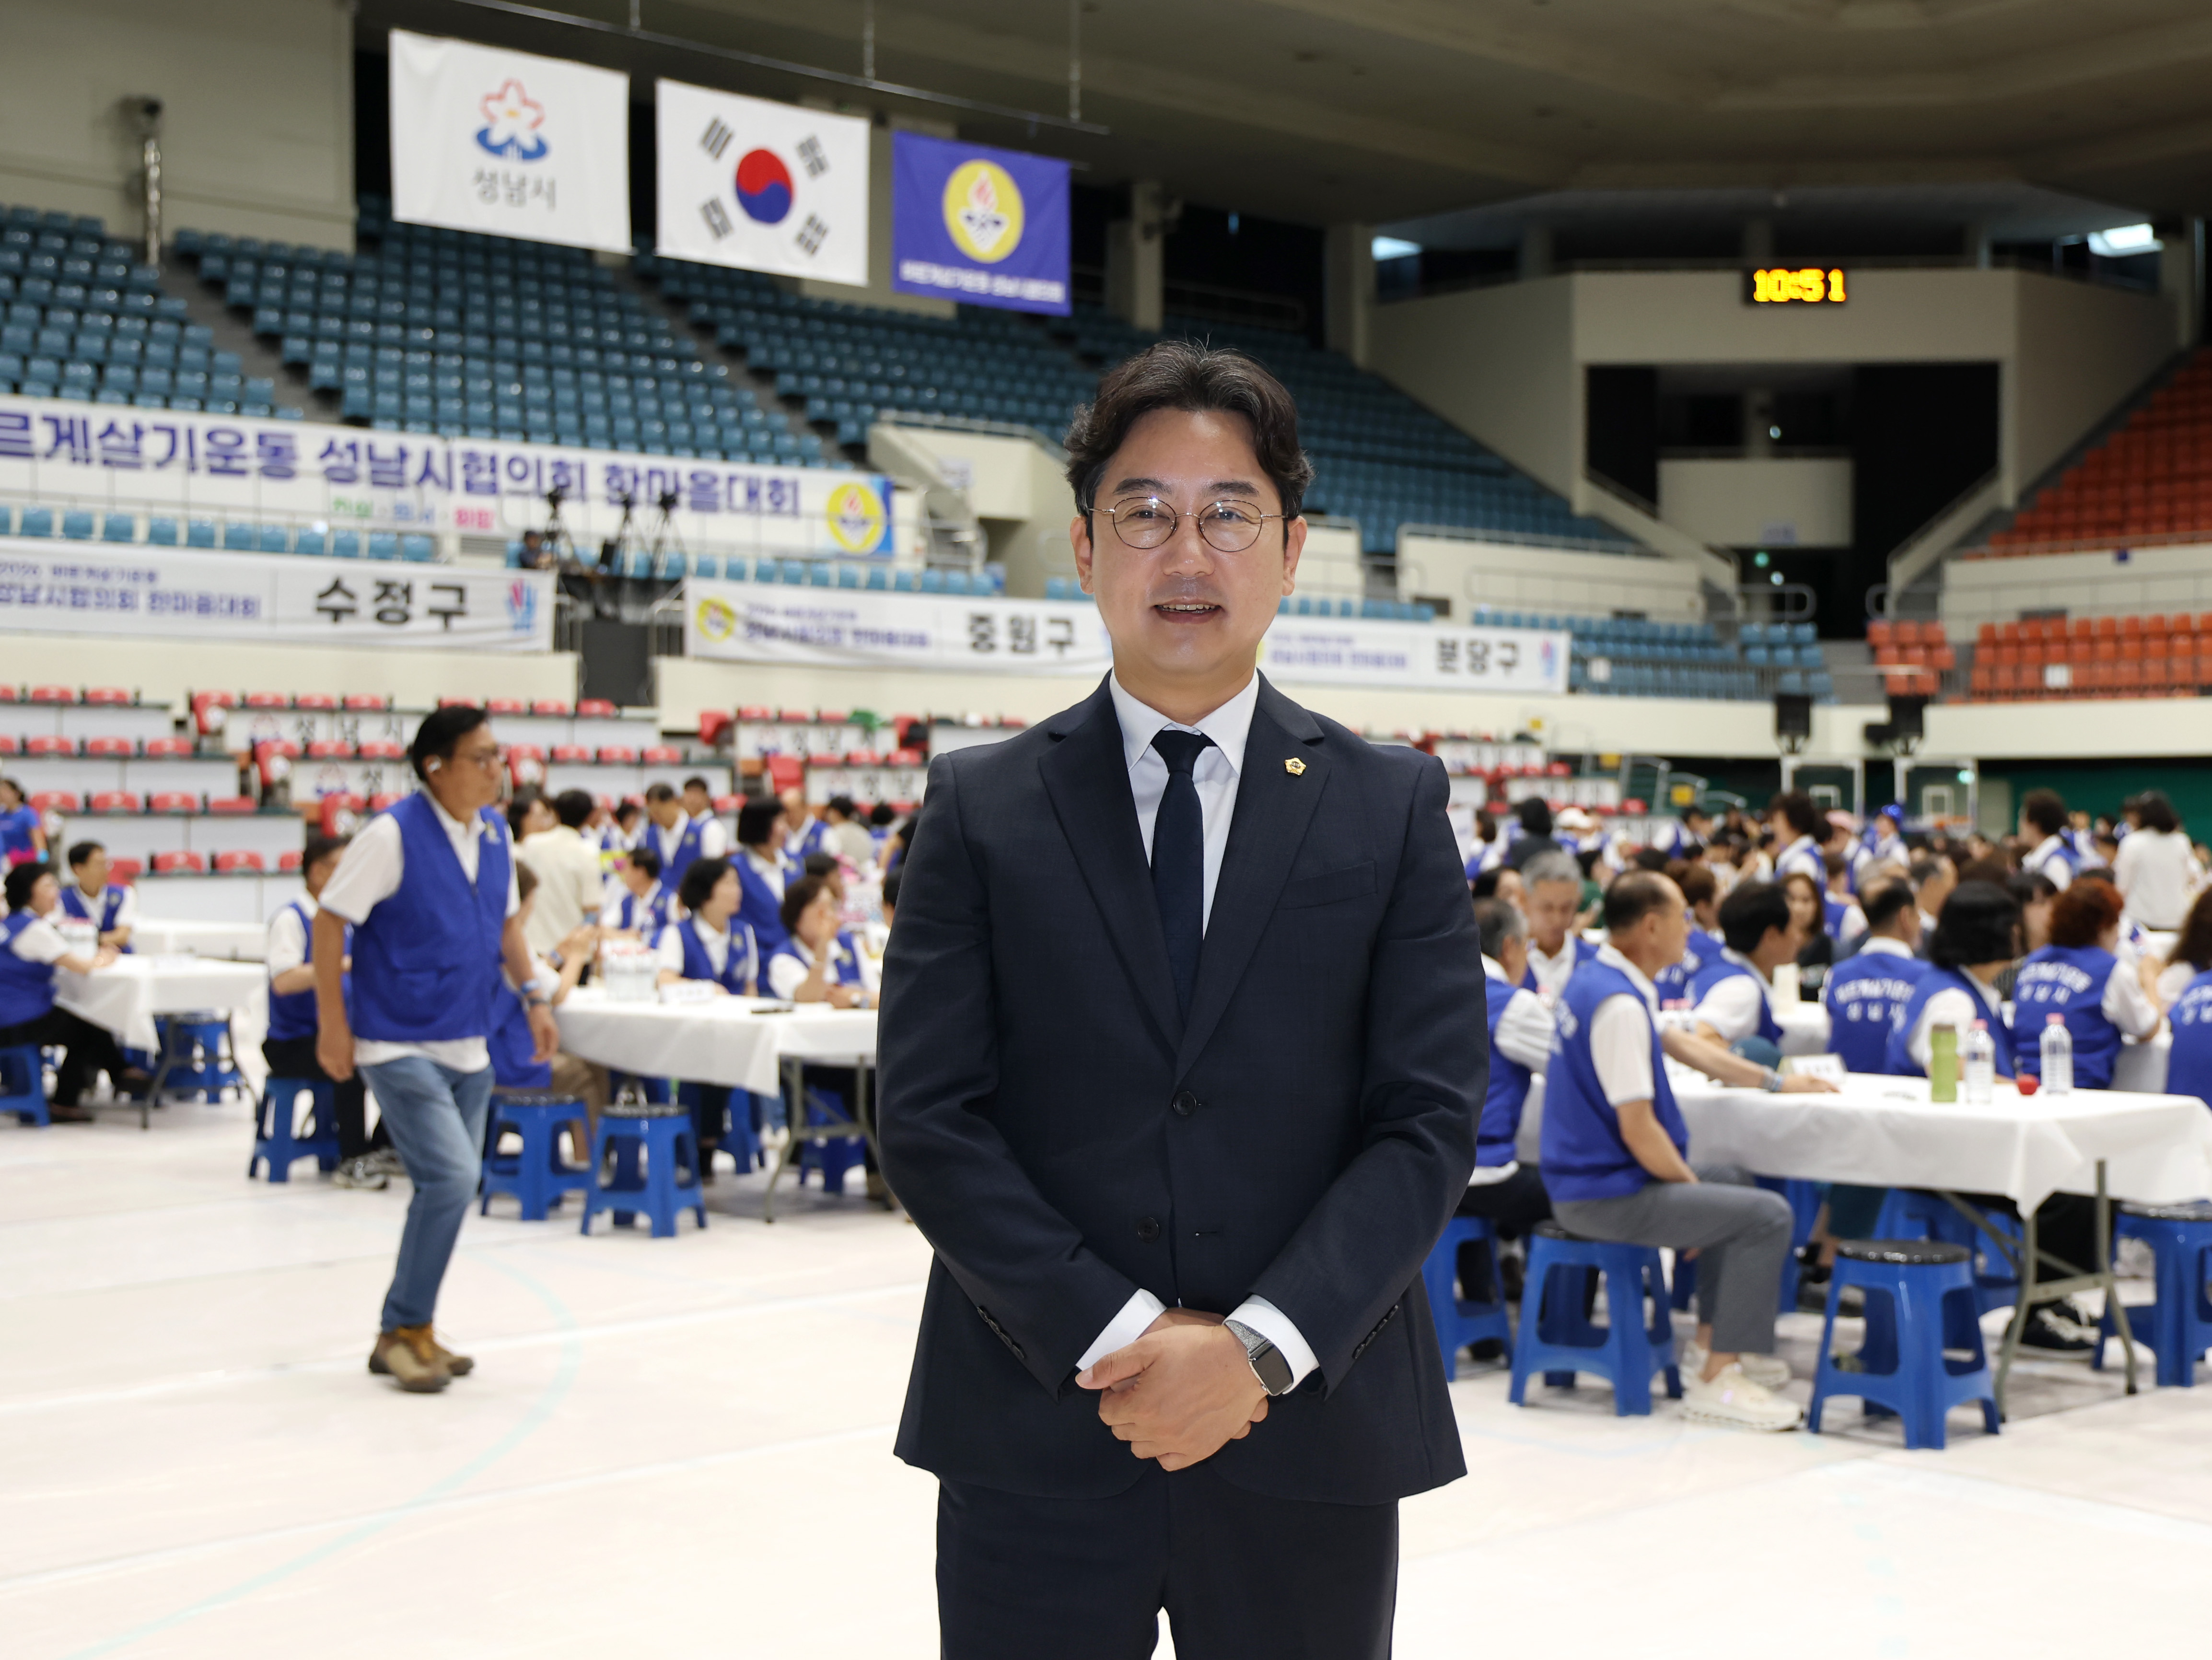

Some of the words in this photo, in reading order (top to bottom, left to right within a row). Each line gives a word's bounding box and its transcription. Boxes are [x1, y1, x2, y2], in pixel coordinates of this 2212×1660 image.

[474, 168, 557, 210] 성남시
[1753, 268, 1847, 302] 10:51
[318, 437, 587, 503] 성남시협의회
[605, 459, 801, 519] 한마음대회
[315, 576, 468, 632] 수정구
[968, 612, 1074, 658] 중원구
[1436, 637, 1521, 675] 분당구
